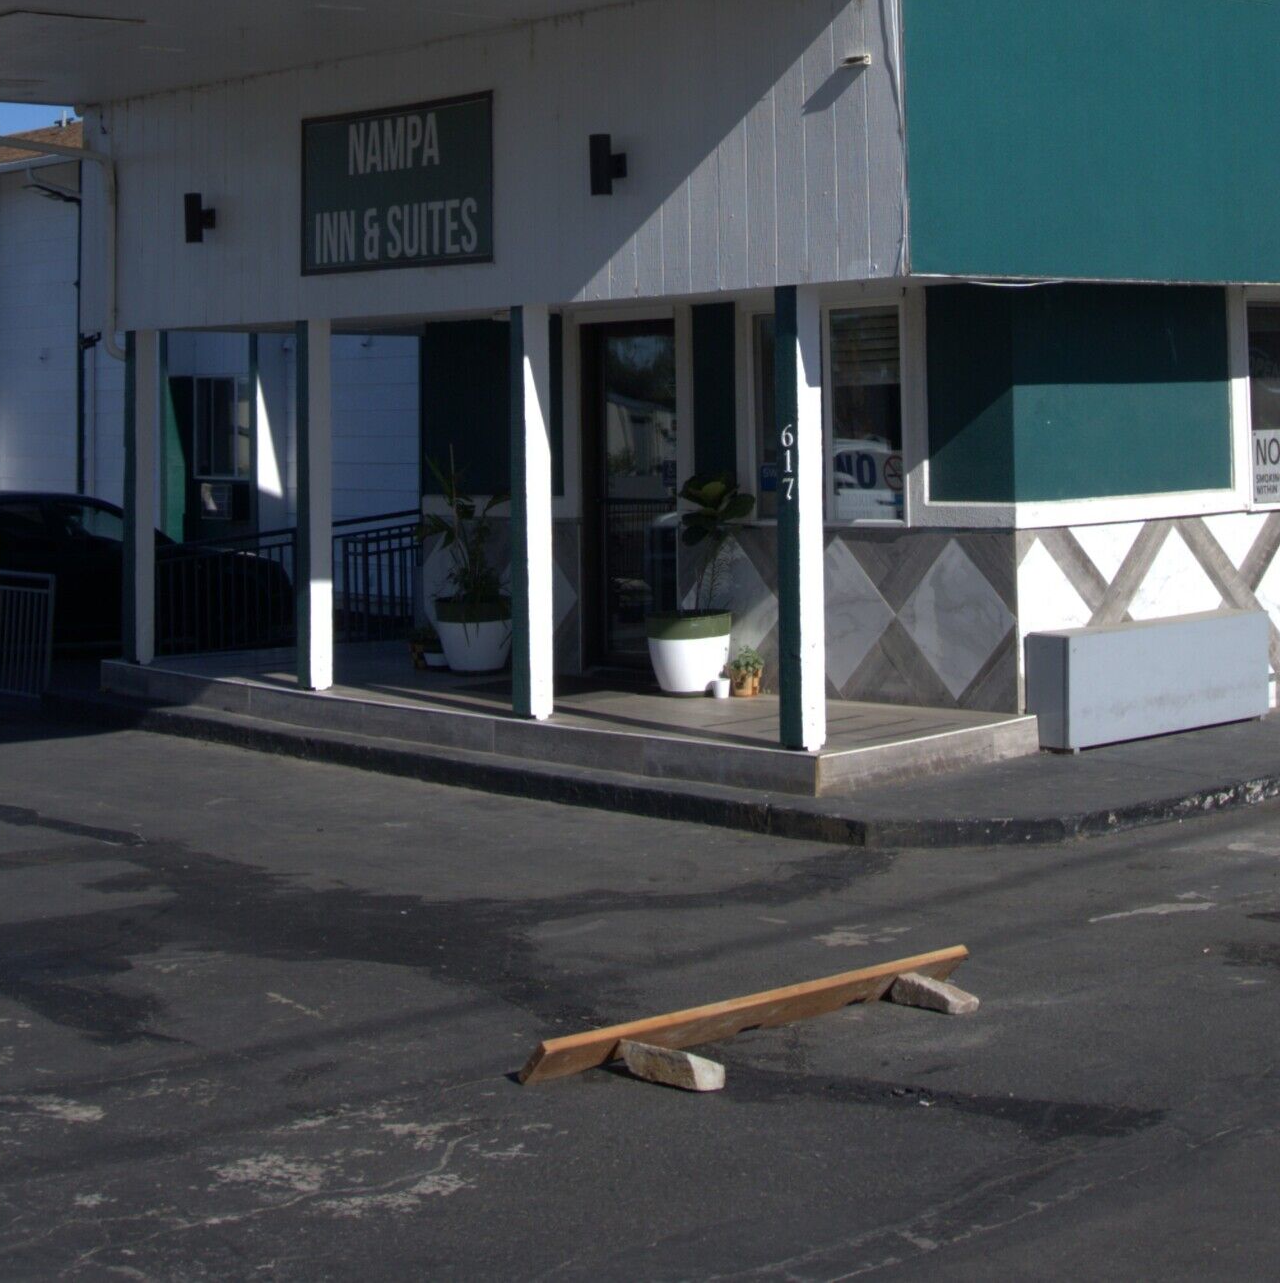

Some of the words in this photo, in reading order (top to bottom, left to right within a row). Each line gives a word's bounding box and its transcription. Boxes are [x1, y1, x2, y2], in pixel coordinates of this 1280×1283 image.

[348, 112, 441, 176] NAMPA
[314, 210, 356, 265] INN
[363, 207, 381, 261] &
[386, 197, 478, 259] SUITES
[780, 424, 795, 501] 617
[1256, 484, 1278, 495] WITHIN
